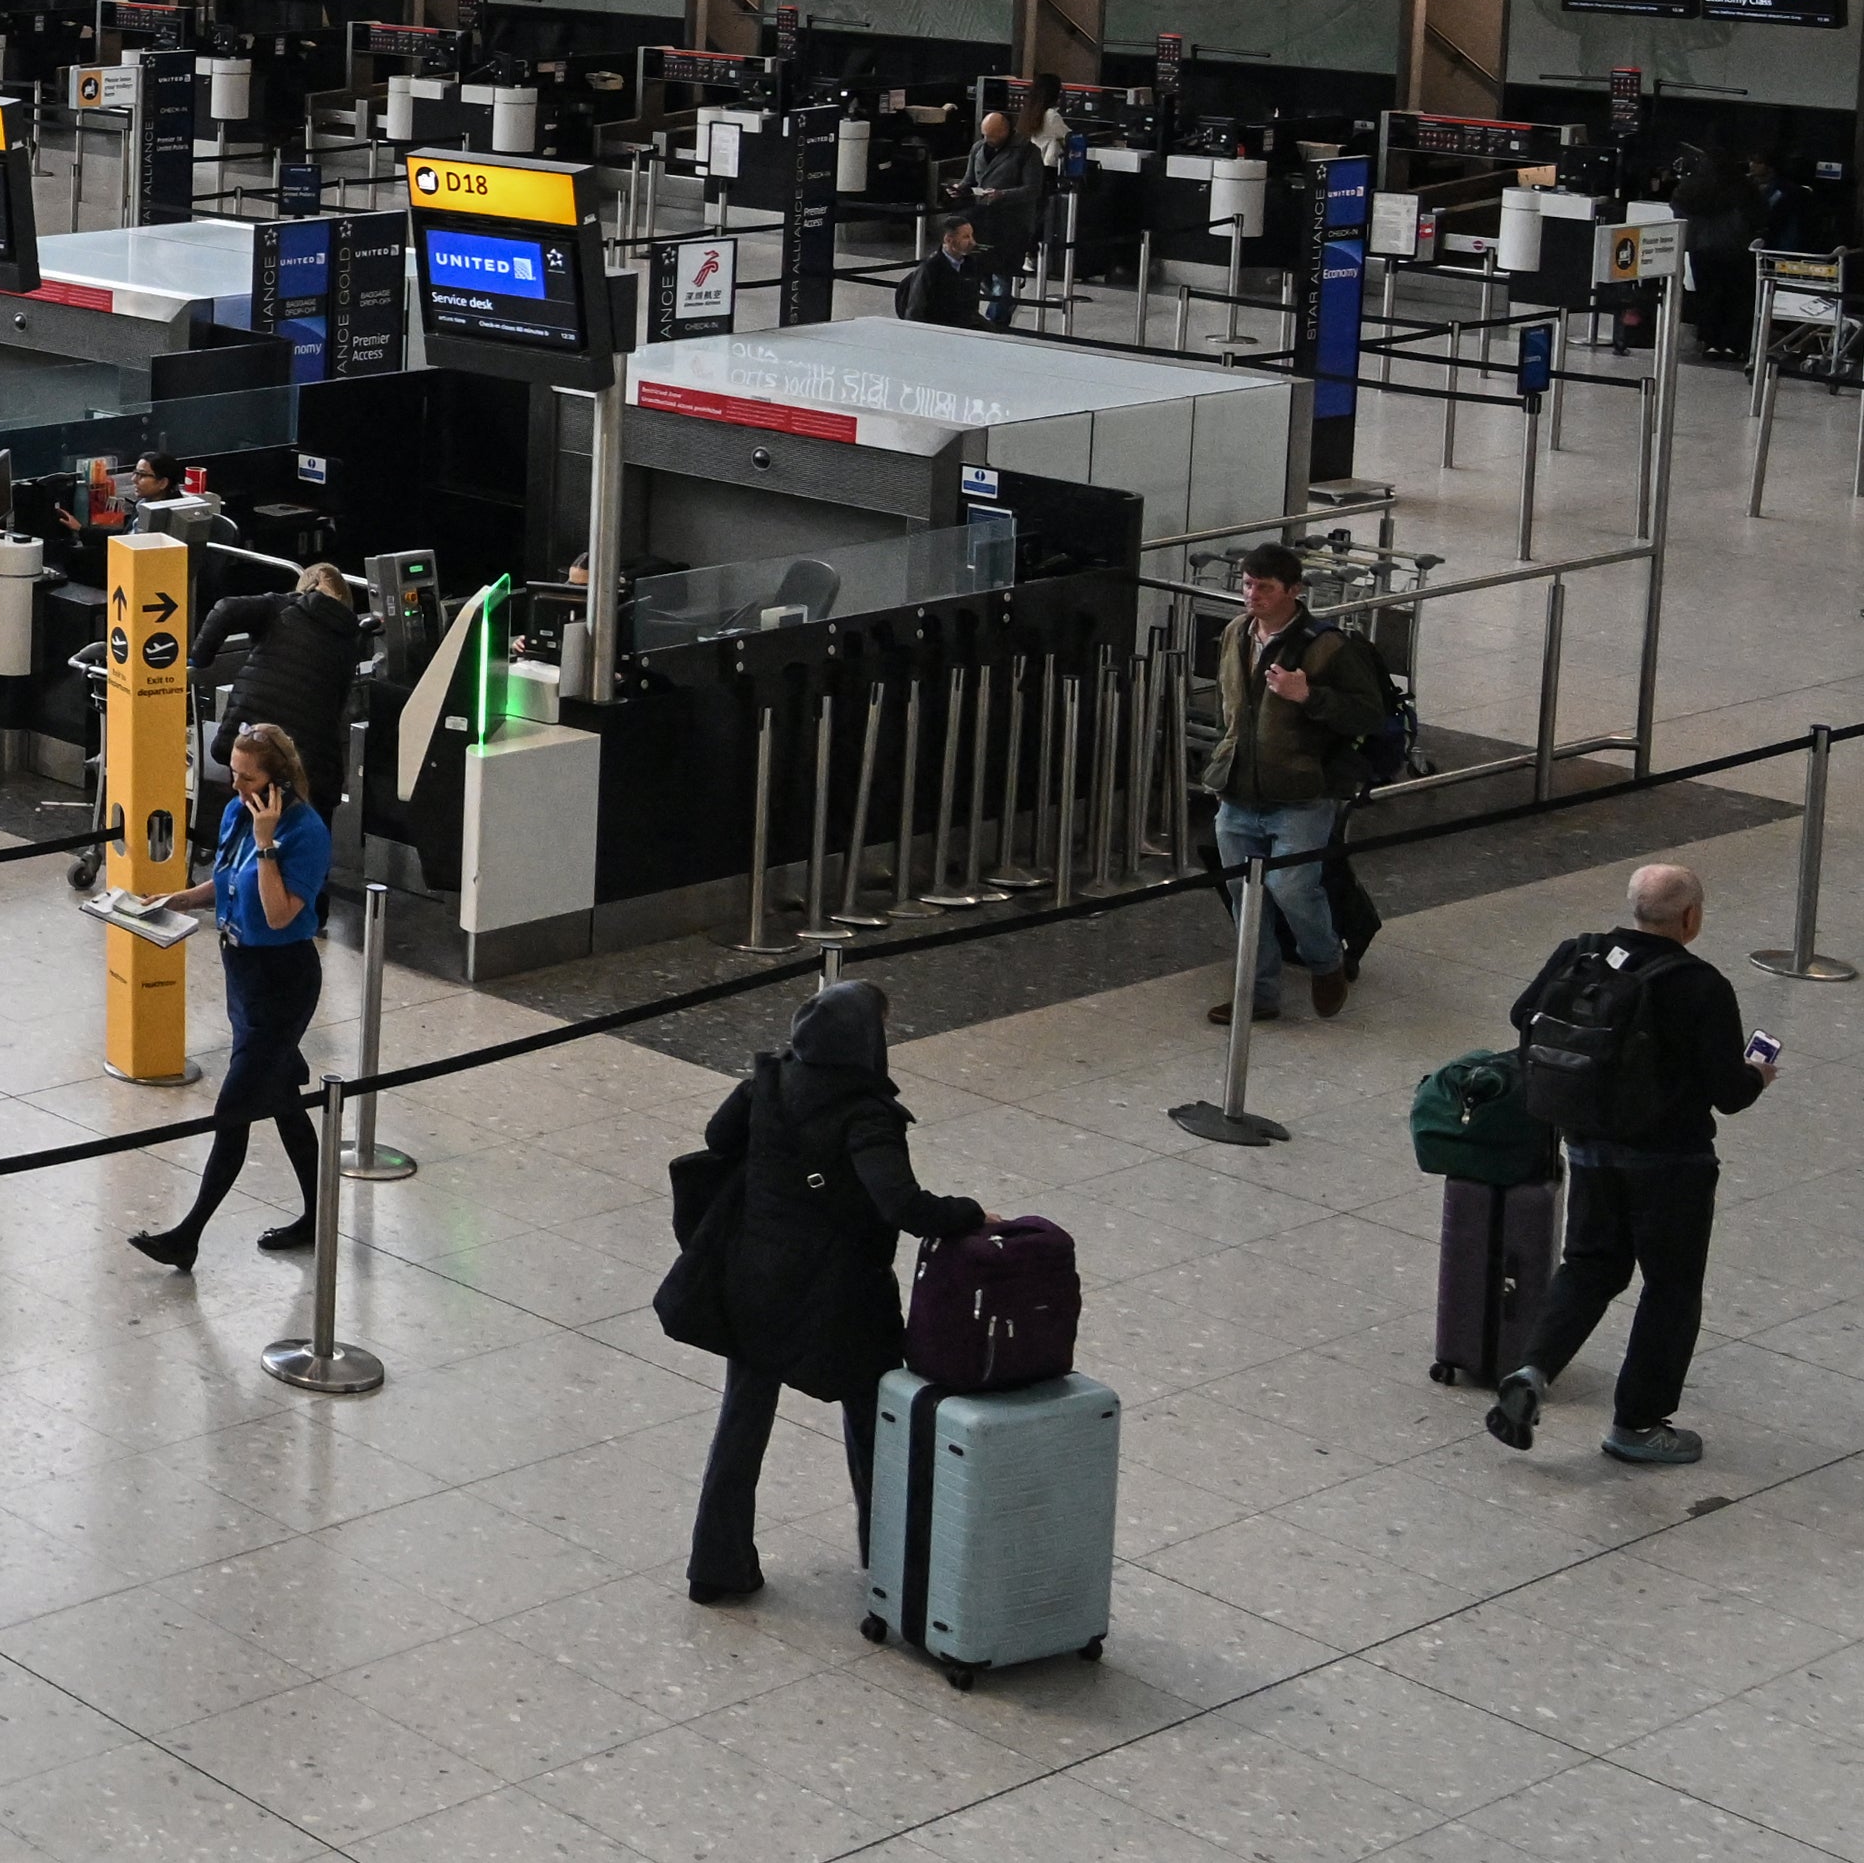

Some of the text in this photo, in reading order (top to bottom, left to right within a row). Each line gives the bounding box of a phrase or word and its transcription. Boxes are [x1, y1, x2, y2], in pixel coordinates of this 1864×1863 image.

[144, 120, 154, 194] ALLIANCE
[446, 172, 488, 195] D18
[1328, 190, 1355, 198] UNITED
[803, 205, 828, 217] Premier
[803, 217, 822, 228] Access
[1328, 229, 1358, 237] CHECK-IN
[355, 248, 389, 257] UNITED
[280, 257, 314, 266] UNITED
[435, 252, 509, 273] UNITED
[1307, 189, 1325, 340] STAR ALLIANCE
[339, 248, 351, 304] GOLD
[1323, 268, 1358, 279] Economy
[432, 292, 493, 310] Service desk
[685, 321, 719, 331] CHECK-IN
[353, 333, 390, 347] Premier
[352, 349, 383, 361] Access
[147, 675, 174, 684] Exit to
[137, 686, 183, 697] departures
